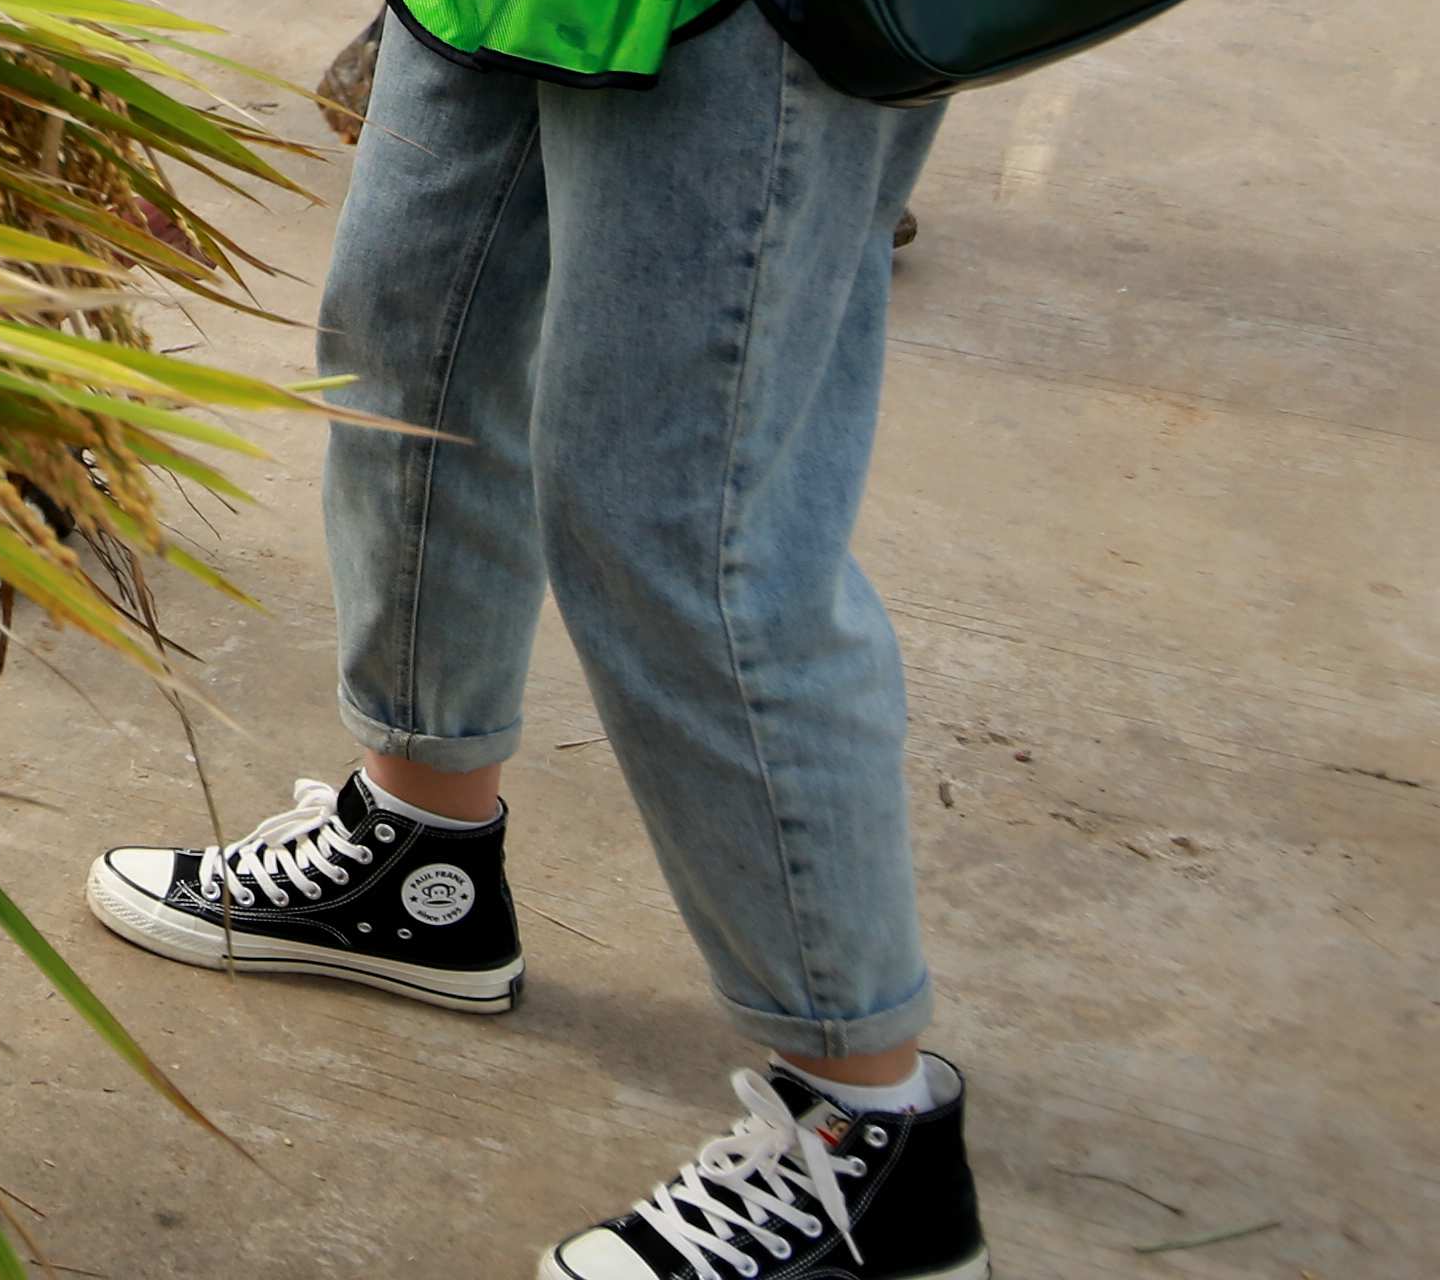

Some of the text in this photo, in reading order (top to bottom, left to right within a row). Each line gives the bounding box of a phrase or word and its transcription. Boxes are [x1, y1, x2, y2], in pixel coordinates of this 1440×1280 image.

[410, 870, 466, 890] PAUL FRANK
[417, 910, 440, 922] since
